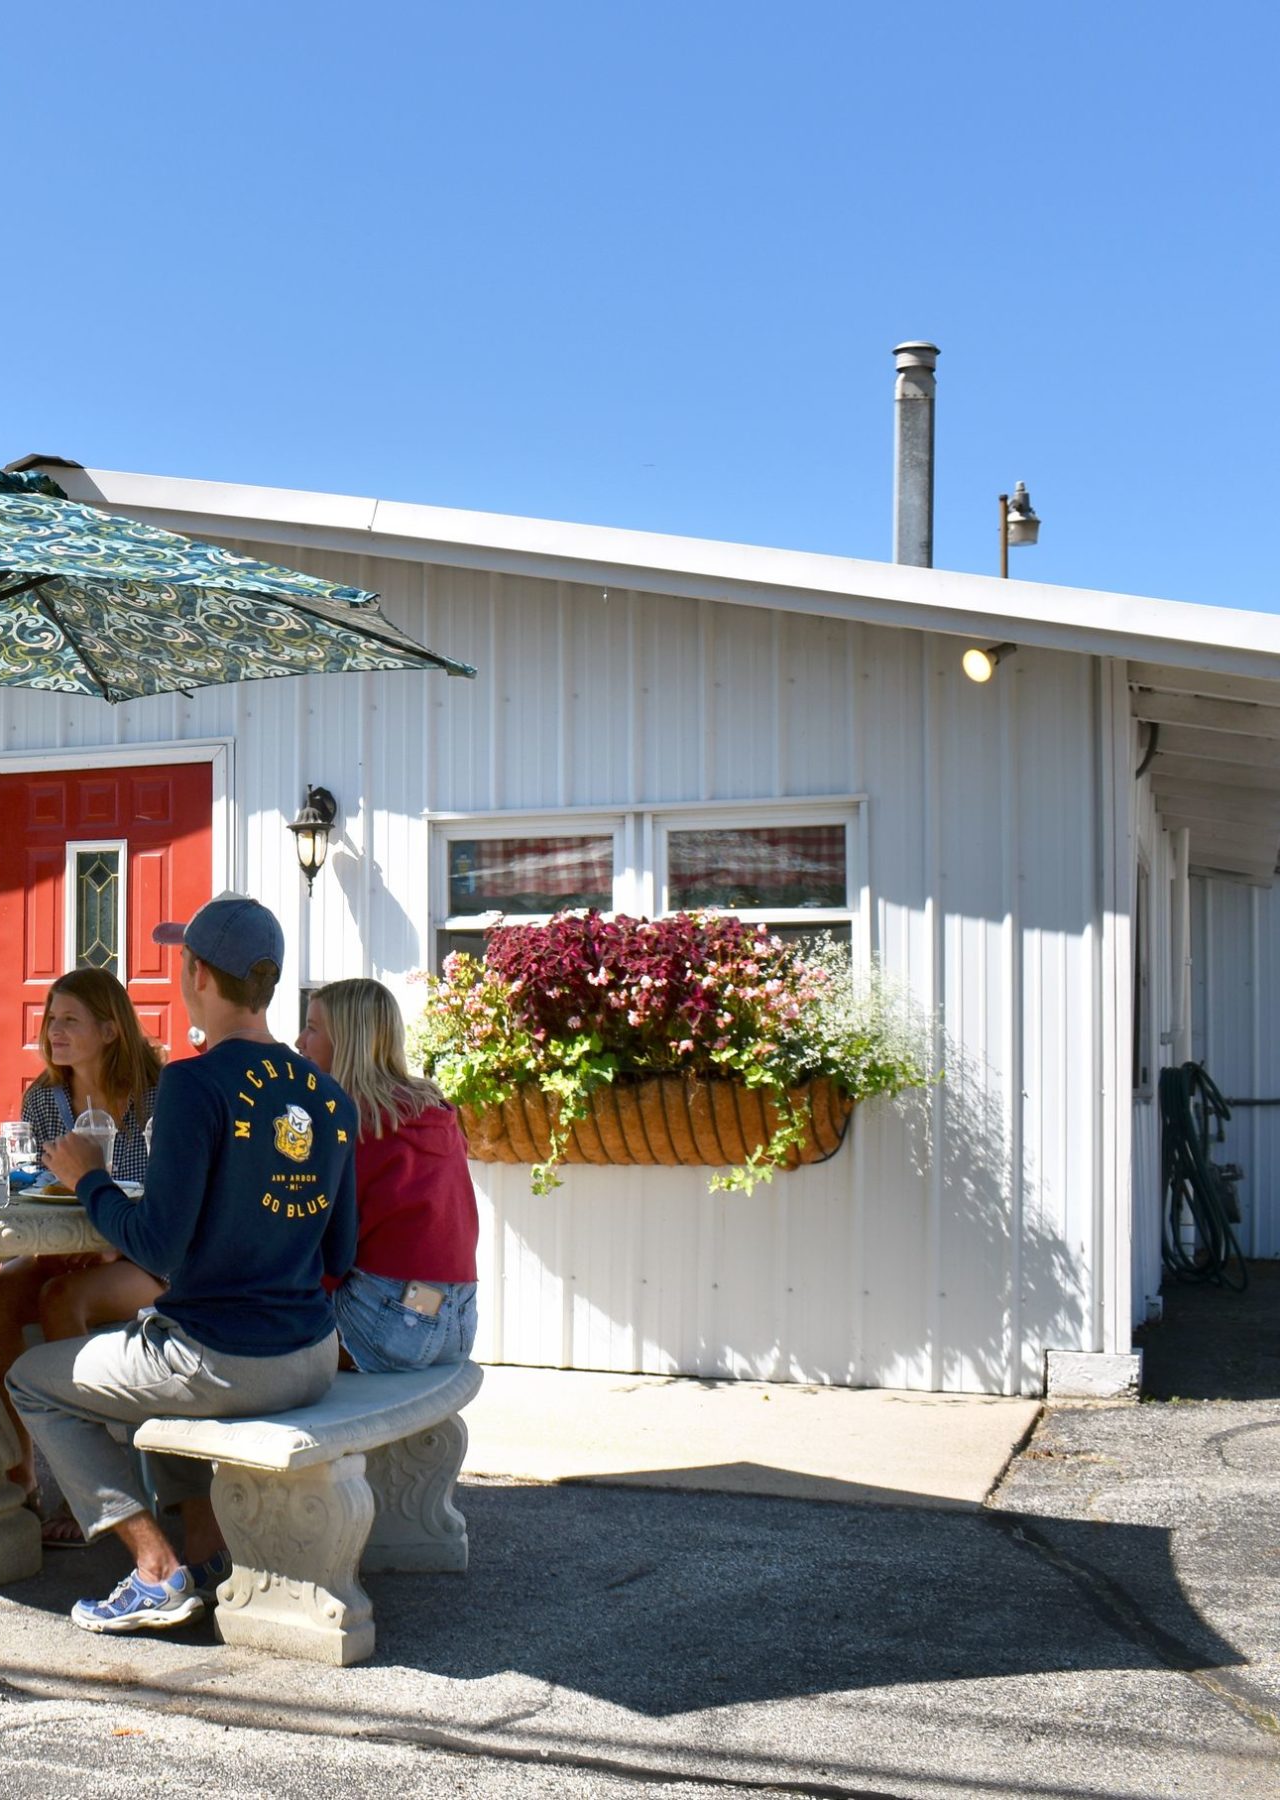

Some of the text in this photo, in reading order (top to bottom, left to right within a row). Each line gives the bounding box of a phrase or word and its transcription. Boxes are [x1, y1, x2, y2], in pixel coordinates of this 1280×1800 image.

[234, 1058, 348, 1143] MICHIGAN
[290, 1174, 317, 1182] ARBOR
[262, 1192, 329, 1218] GO BLUE
